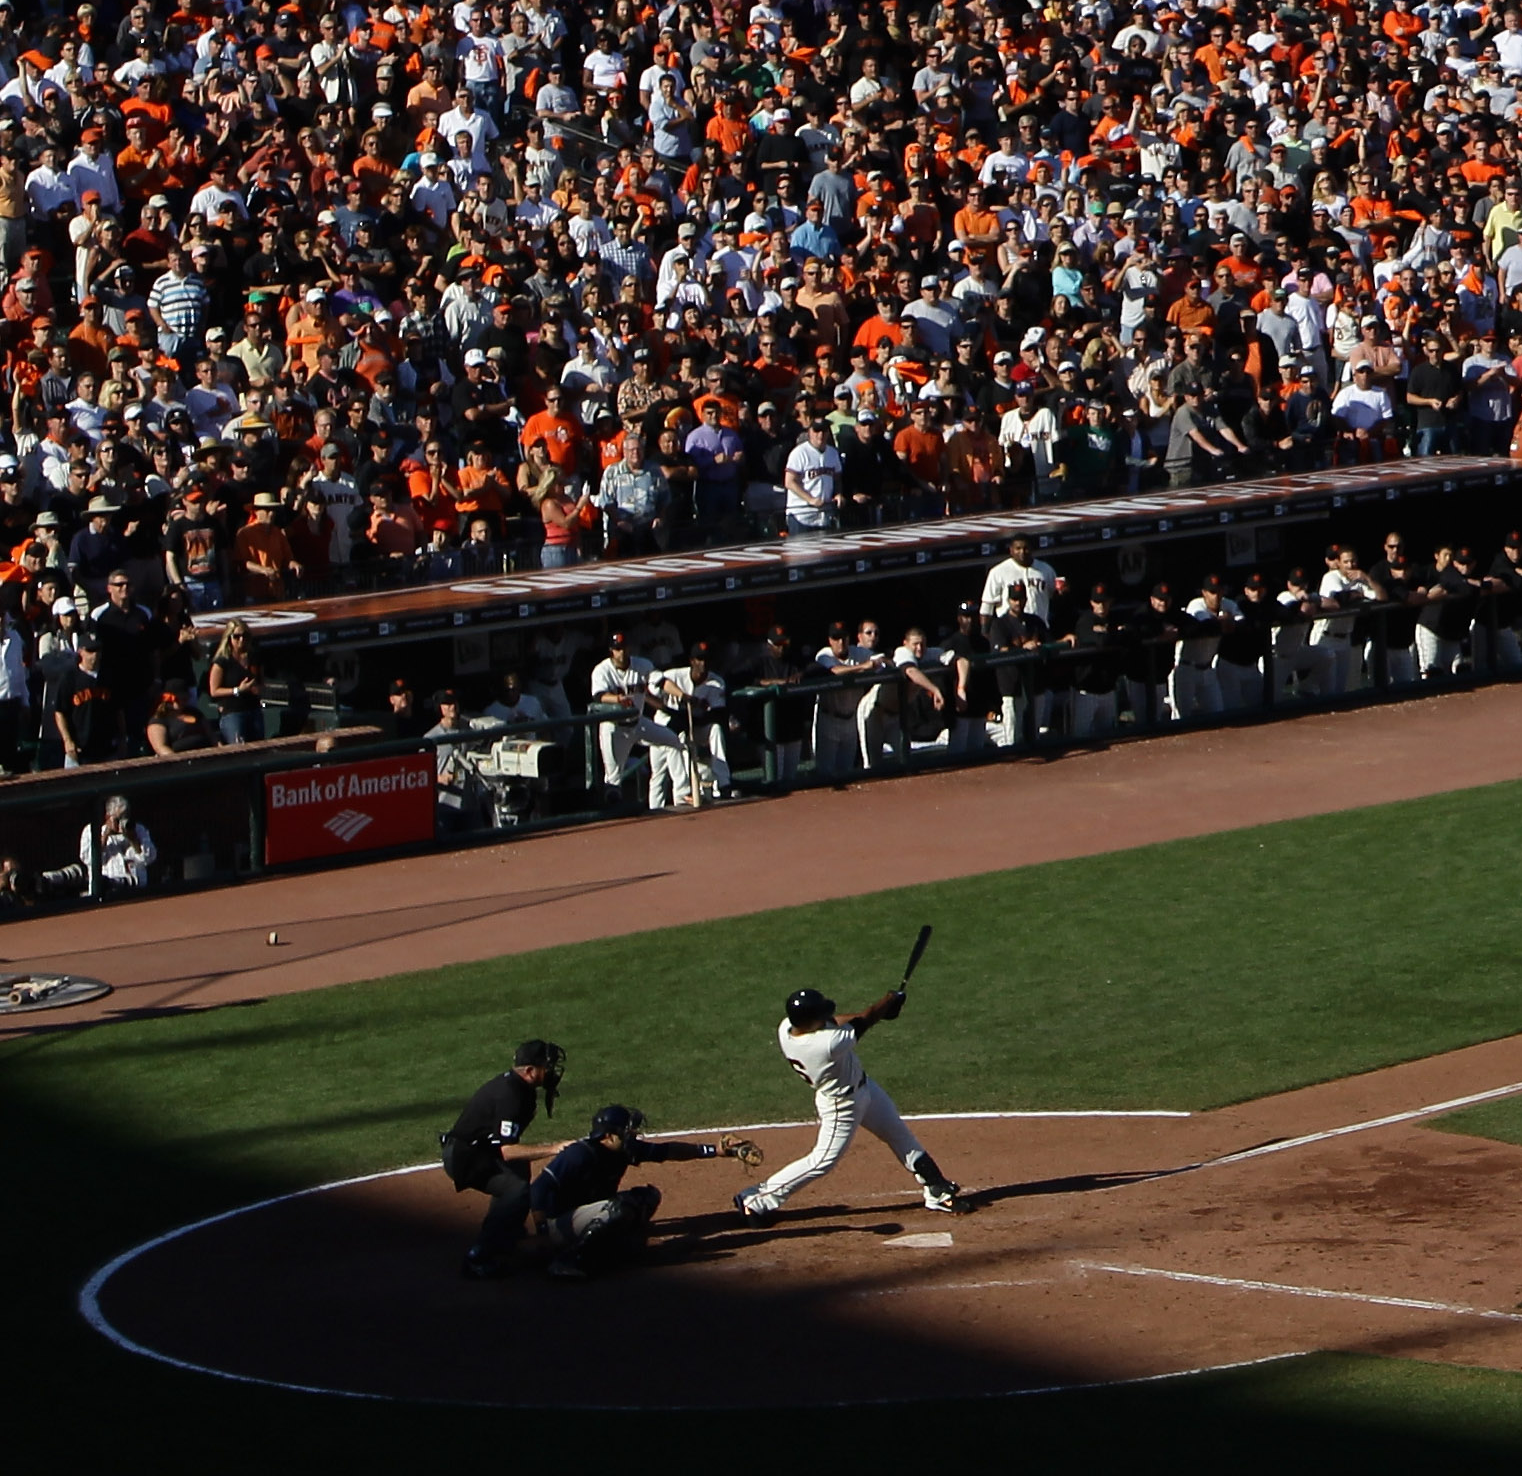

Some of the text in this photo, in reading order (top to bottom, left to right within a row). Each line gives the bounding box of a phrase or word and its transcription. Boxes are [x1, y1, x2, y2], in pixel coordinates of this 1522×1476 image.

[1047, 496, 1207, 517] SAN
[704, 513, 1083, 562] FRANCISCO
[449, 558, 725, 595] GIANTS
[272, 766, 429, 808] Bank of America
